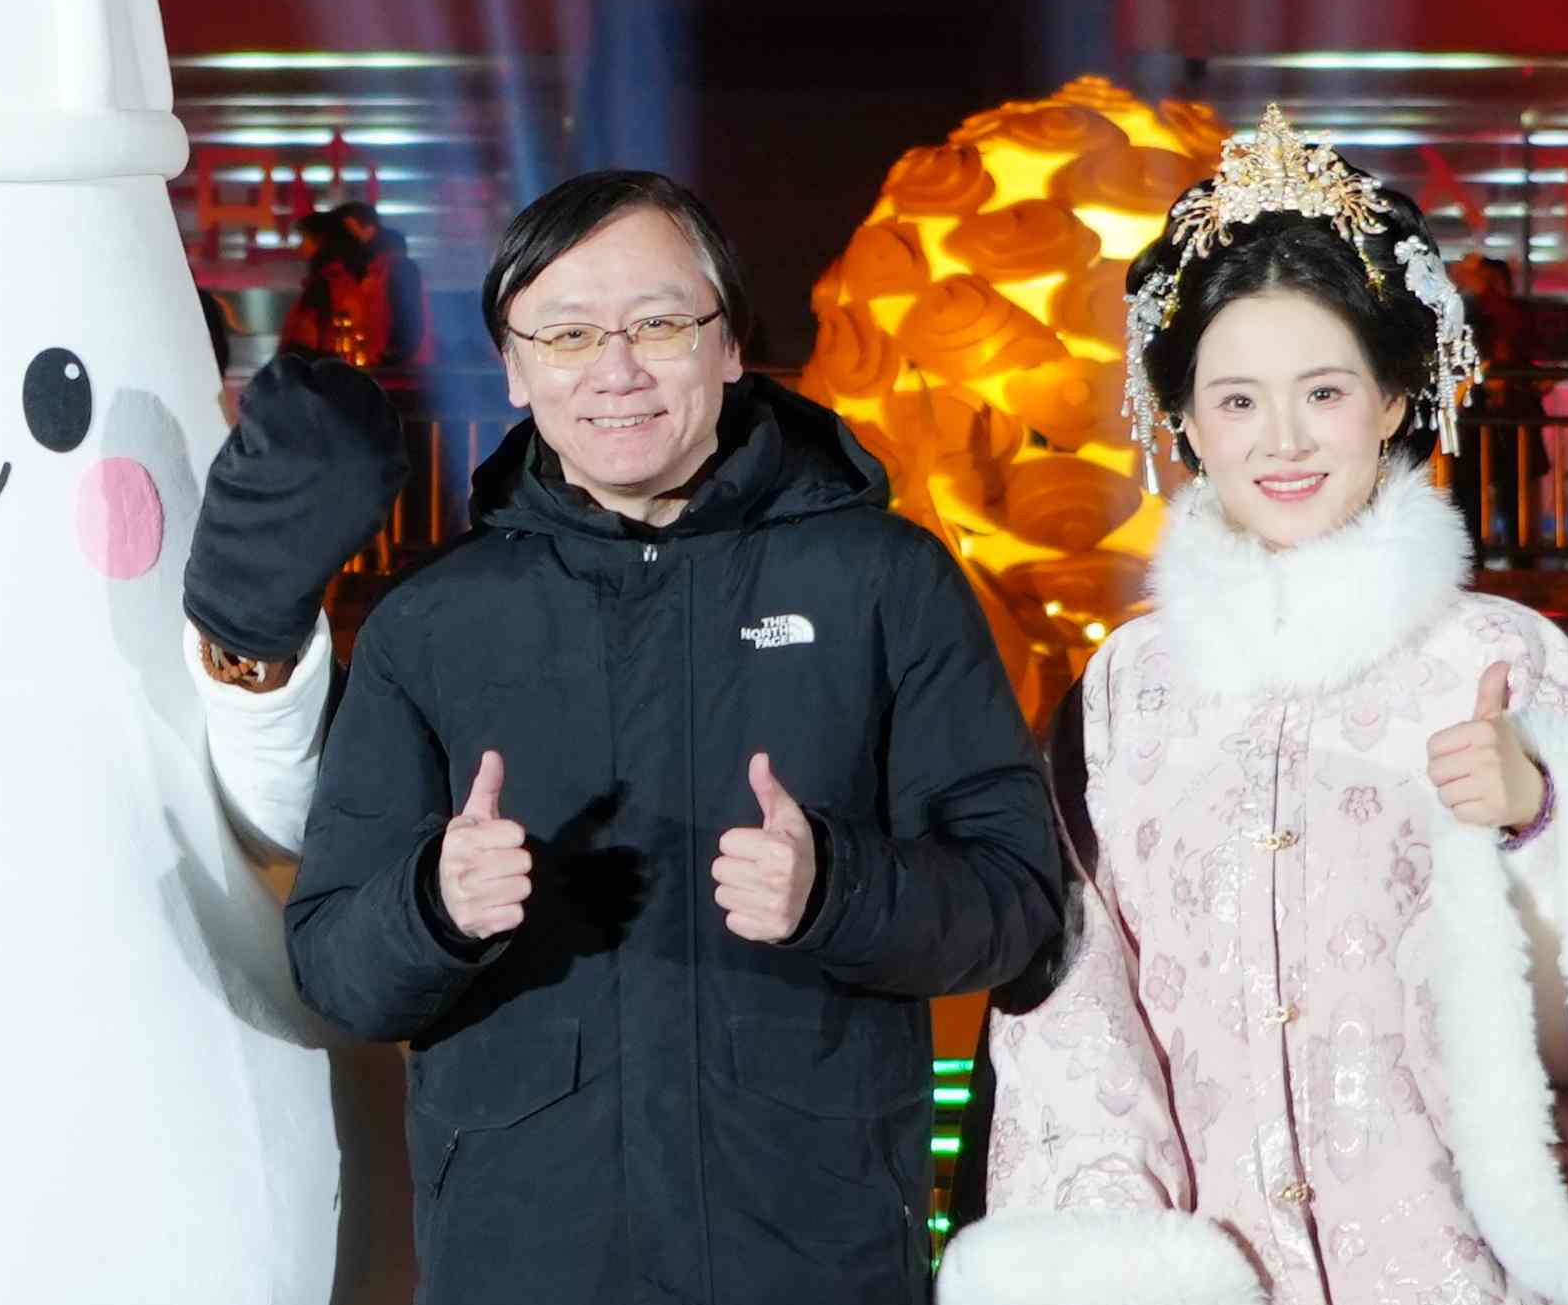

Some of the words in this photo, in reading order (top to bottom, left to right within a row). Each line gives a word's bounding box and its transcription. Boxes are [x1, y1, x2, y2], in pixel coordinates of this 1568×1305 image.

[761, 615, 787, 628] THE
[741, 623, 788, 640] NORTH
[755, 636, 788, 649] FACE
